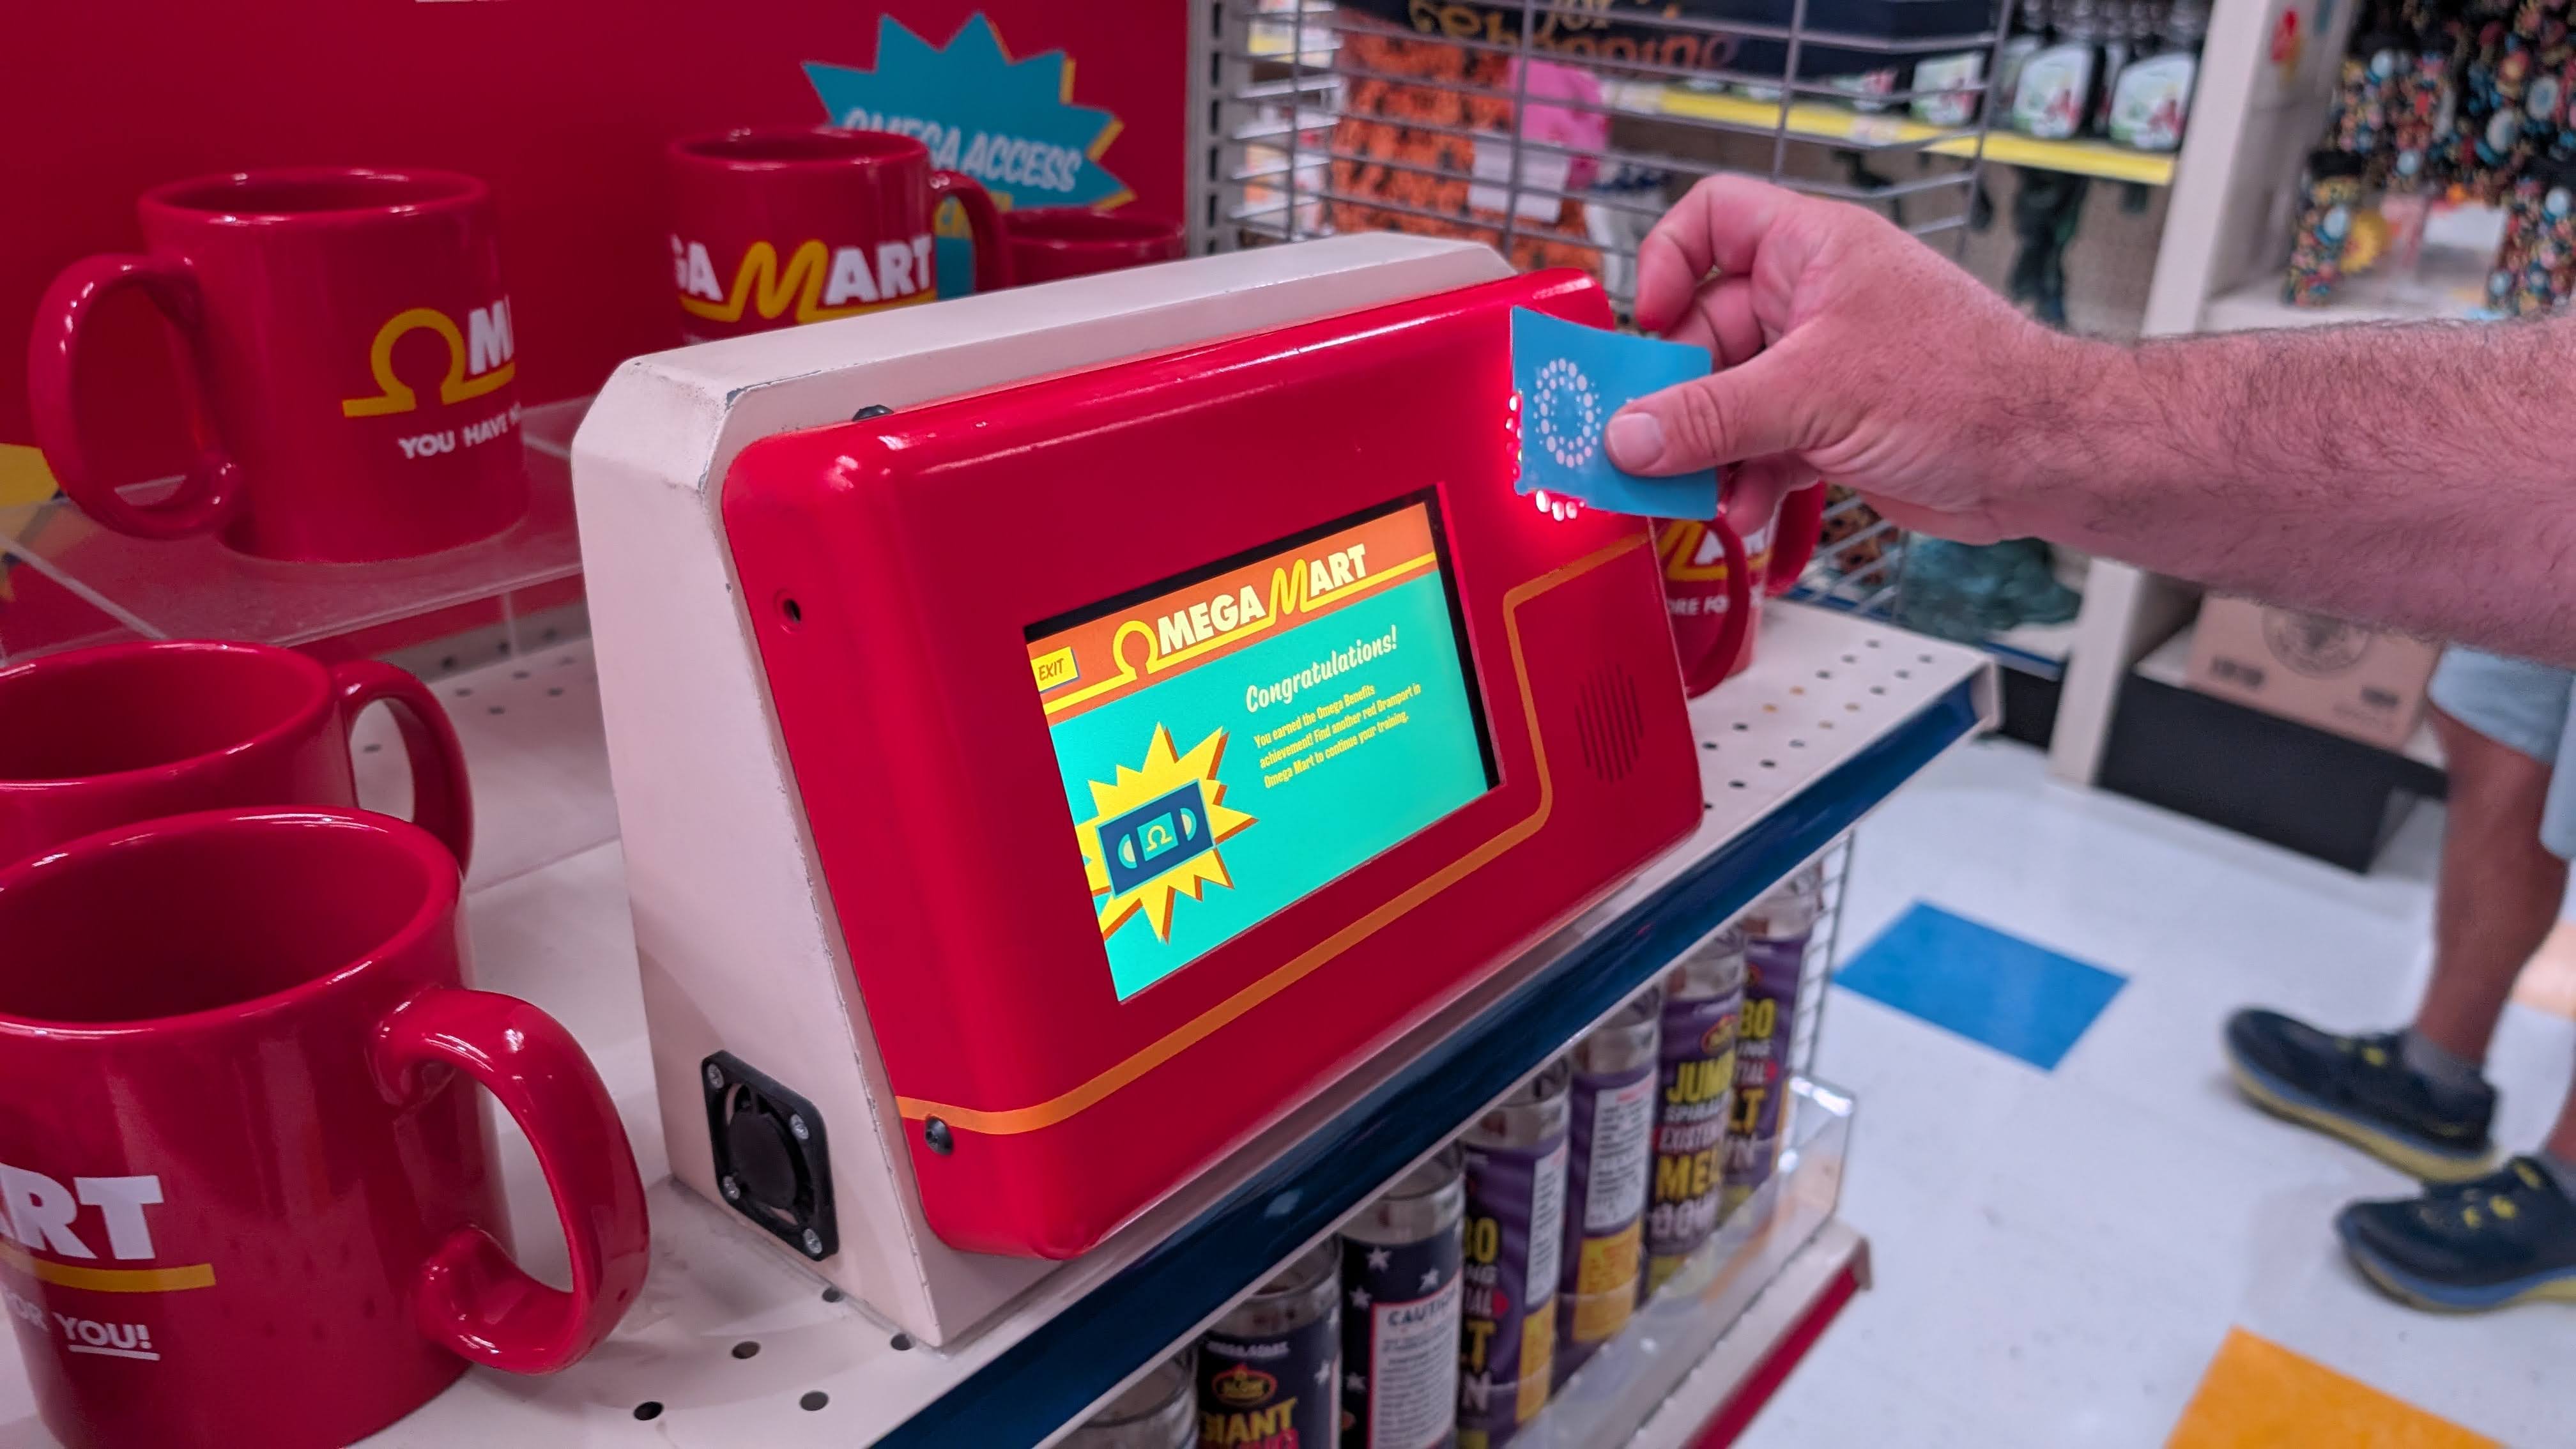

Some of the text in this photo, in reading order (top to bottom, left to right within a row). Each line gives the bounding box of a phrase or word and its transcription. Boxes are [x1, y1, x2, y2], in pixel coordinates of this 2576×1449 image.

[962, 130, 1082, 192] ACCESS
[398, 429, 456, 459] YOU
[1268, 544, 1367, 625] MART
[1038, 658, 1064, 682] EXIT
[1246, 625, 1398, 713] Congratulations!
[1254, 684, 1376, 749] You earned the Omega Benefits
[1259, 732, 1314, 769] achievement!
[1314, 724, 1331, 743] Find
[1331, 711, 1361, 734] another
[1362, 702, 1376, 719] red
[1264, 711, 1410, 789] Omega Mart to continue your training.
[0, 1162, 164, 1260] RT
[52, 1310, 153, 1351] YOU!
